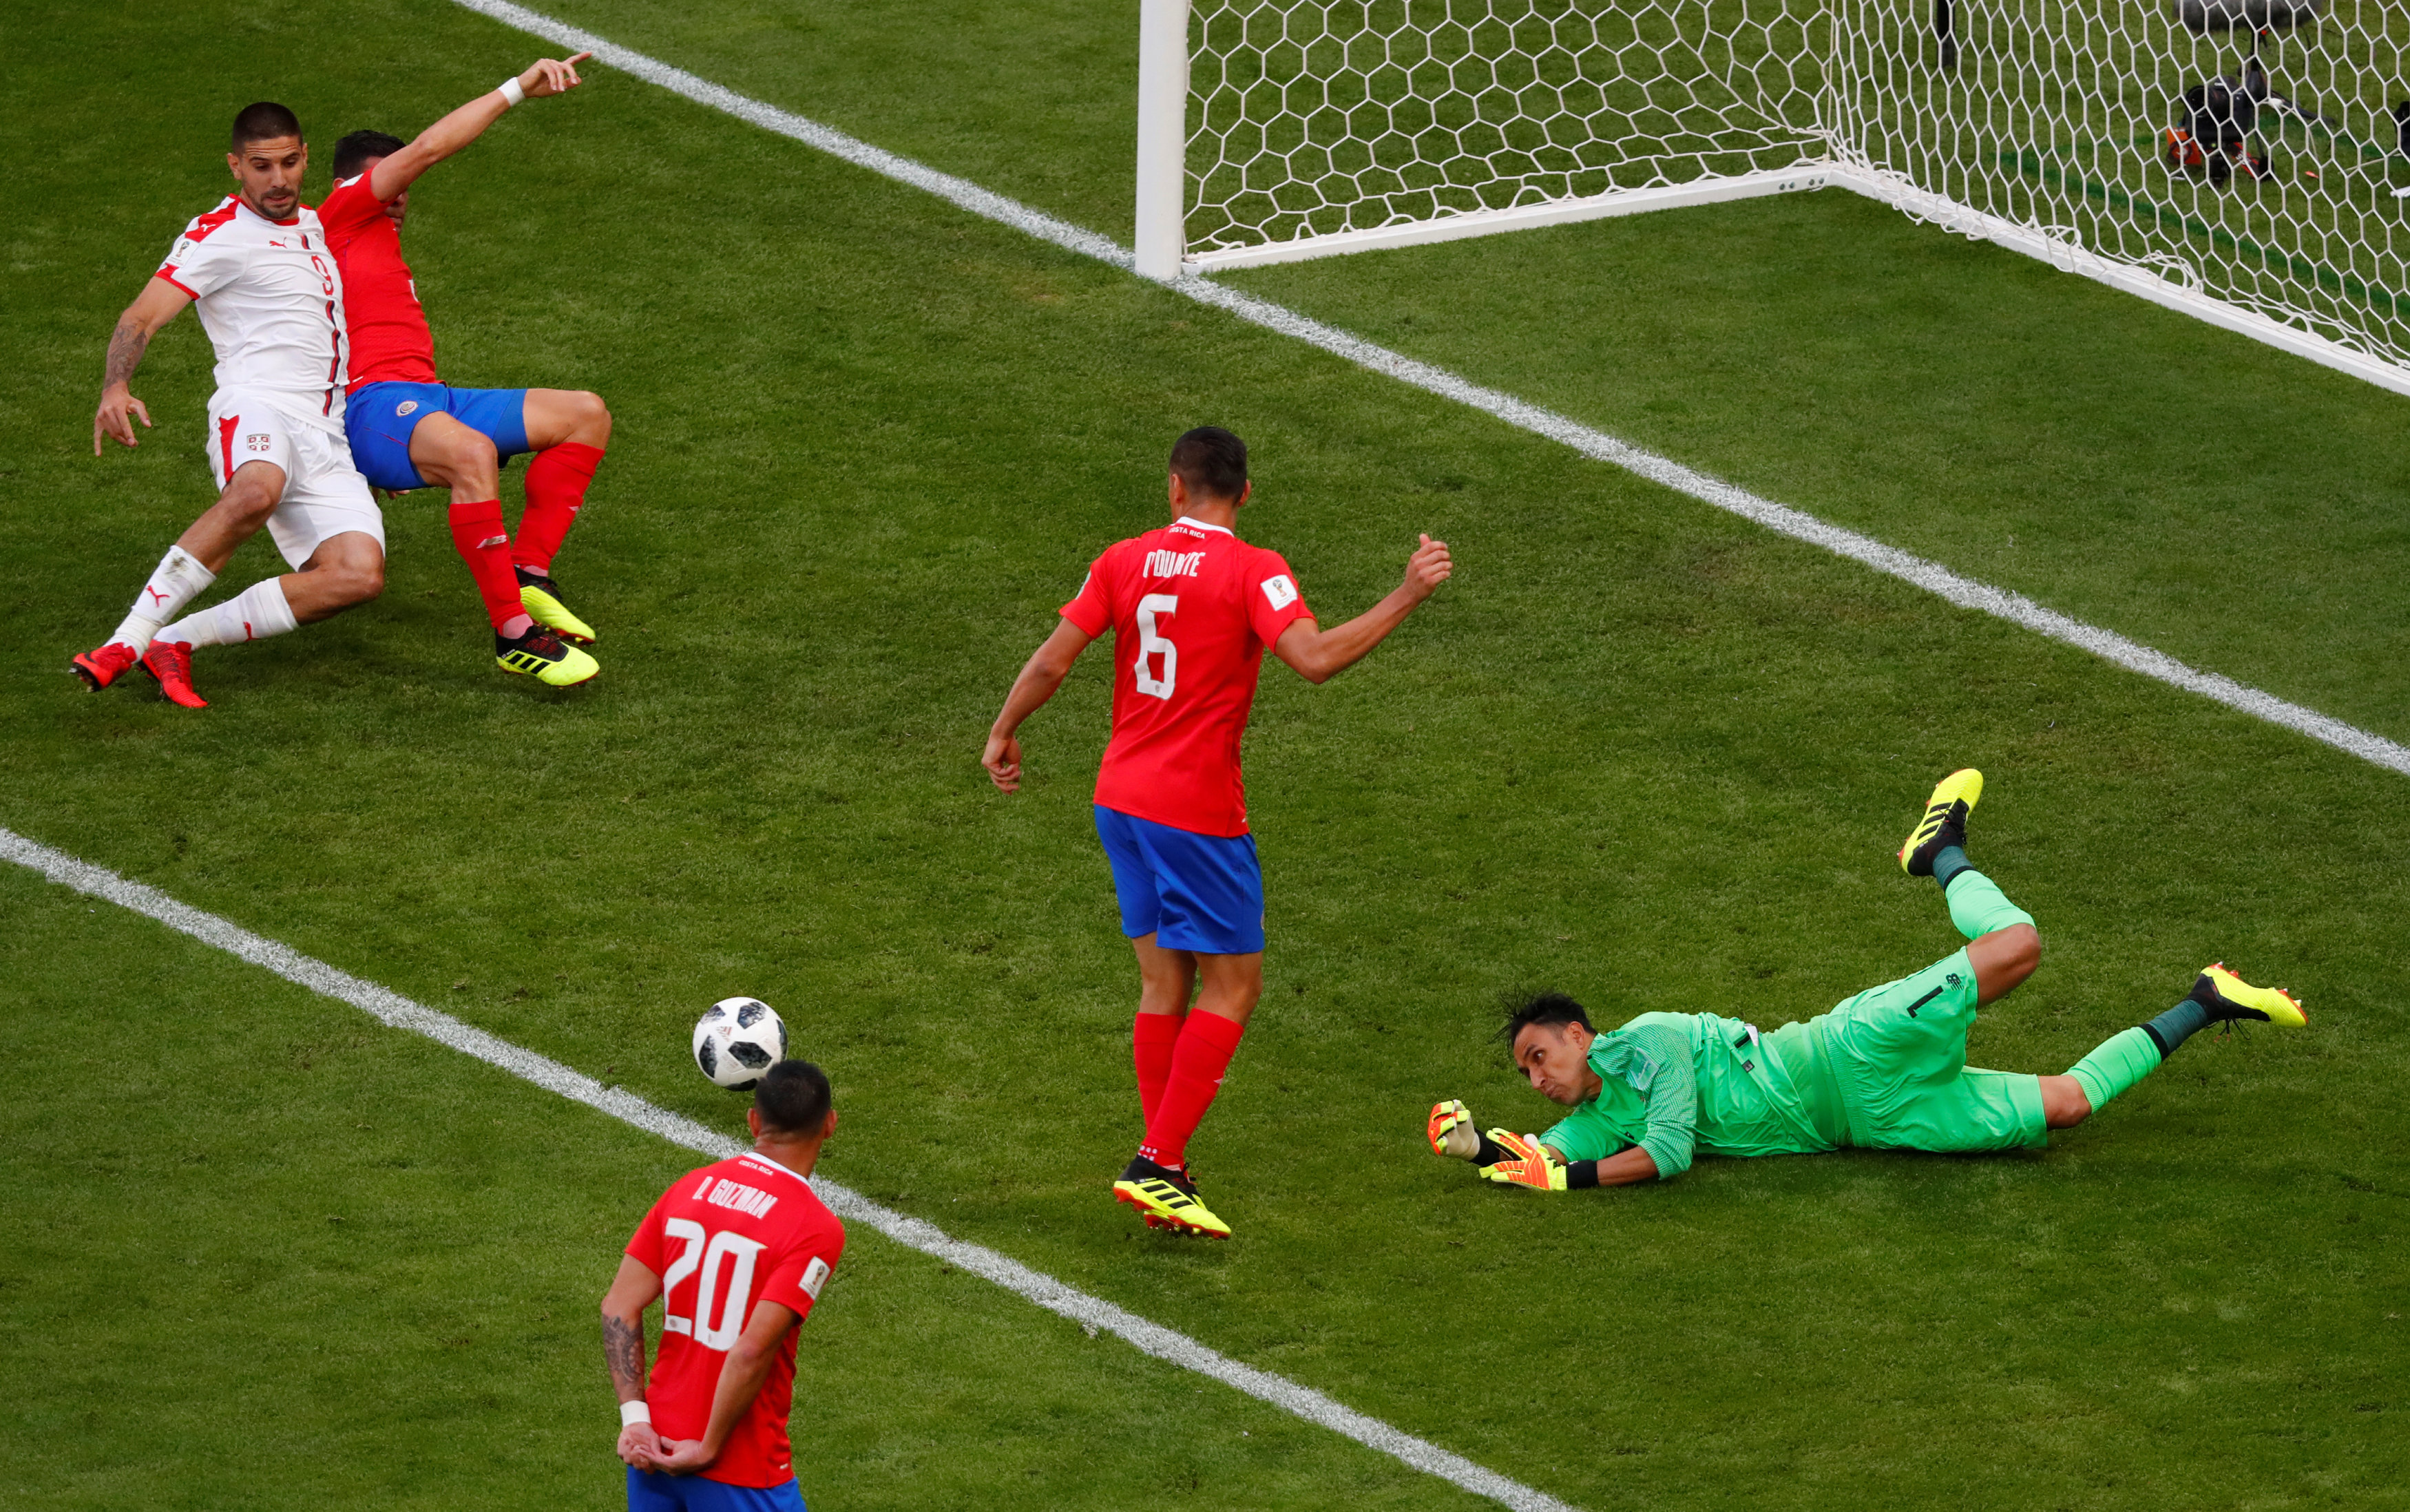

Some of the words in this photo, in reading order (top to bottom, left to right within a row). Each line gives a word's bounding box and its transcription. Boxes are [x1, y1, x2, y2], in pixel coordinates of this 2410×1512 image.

[311, 255, 334, 296] 9
[1189, 529, 1205, 539] RICA
[1134, 593, 1179, 700] 6
[1906, 985, 1944, 1018] 1
[738, 1159, 758, 1170] COSTA
[707, 1179, 779, 1219] GUZMAN
[663, 1217, 768, 1352] 20
